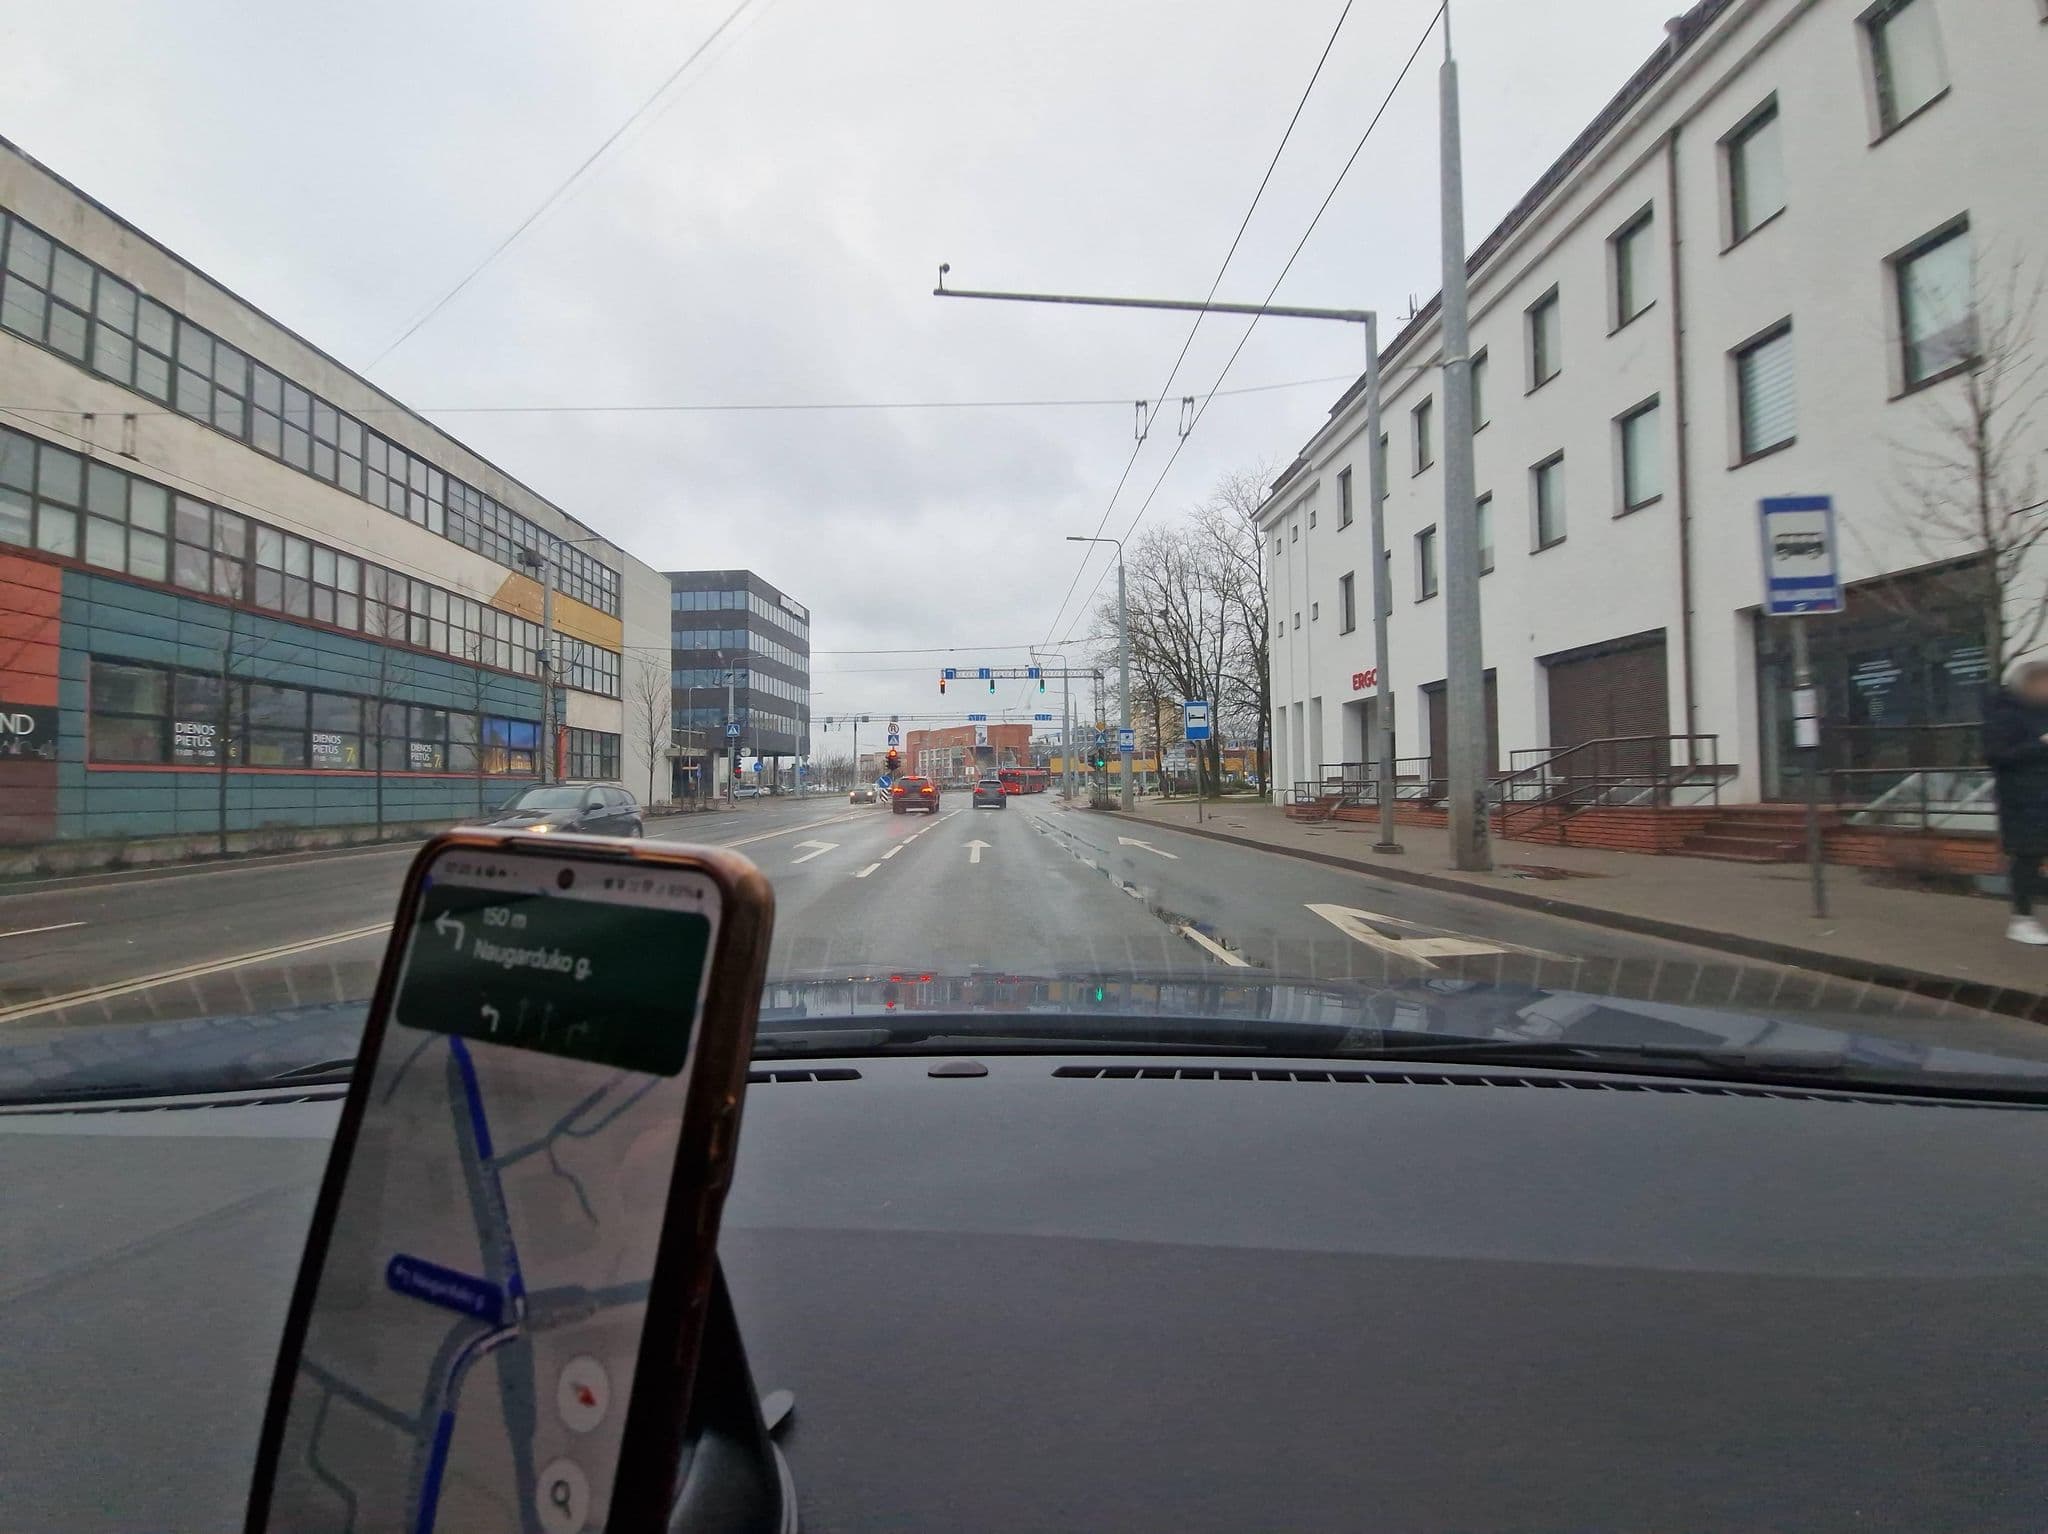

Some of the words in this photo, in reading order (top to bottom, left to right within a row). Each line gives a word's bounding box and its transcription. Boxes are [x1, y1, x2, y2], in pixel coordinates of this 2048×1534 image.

[175, 722, 216, 736] DIENOS
[312, 733, 342, 745] DIENOS
[410, 742, 433, 752] DIENOS
[483, 906, 511, 928] 150
[511, 914, 528, 929] m
[472, 937, 573, 975] Naugarduko
